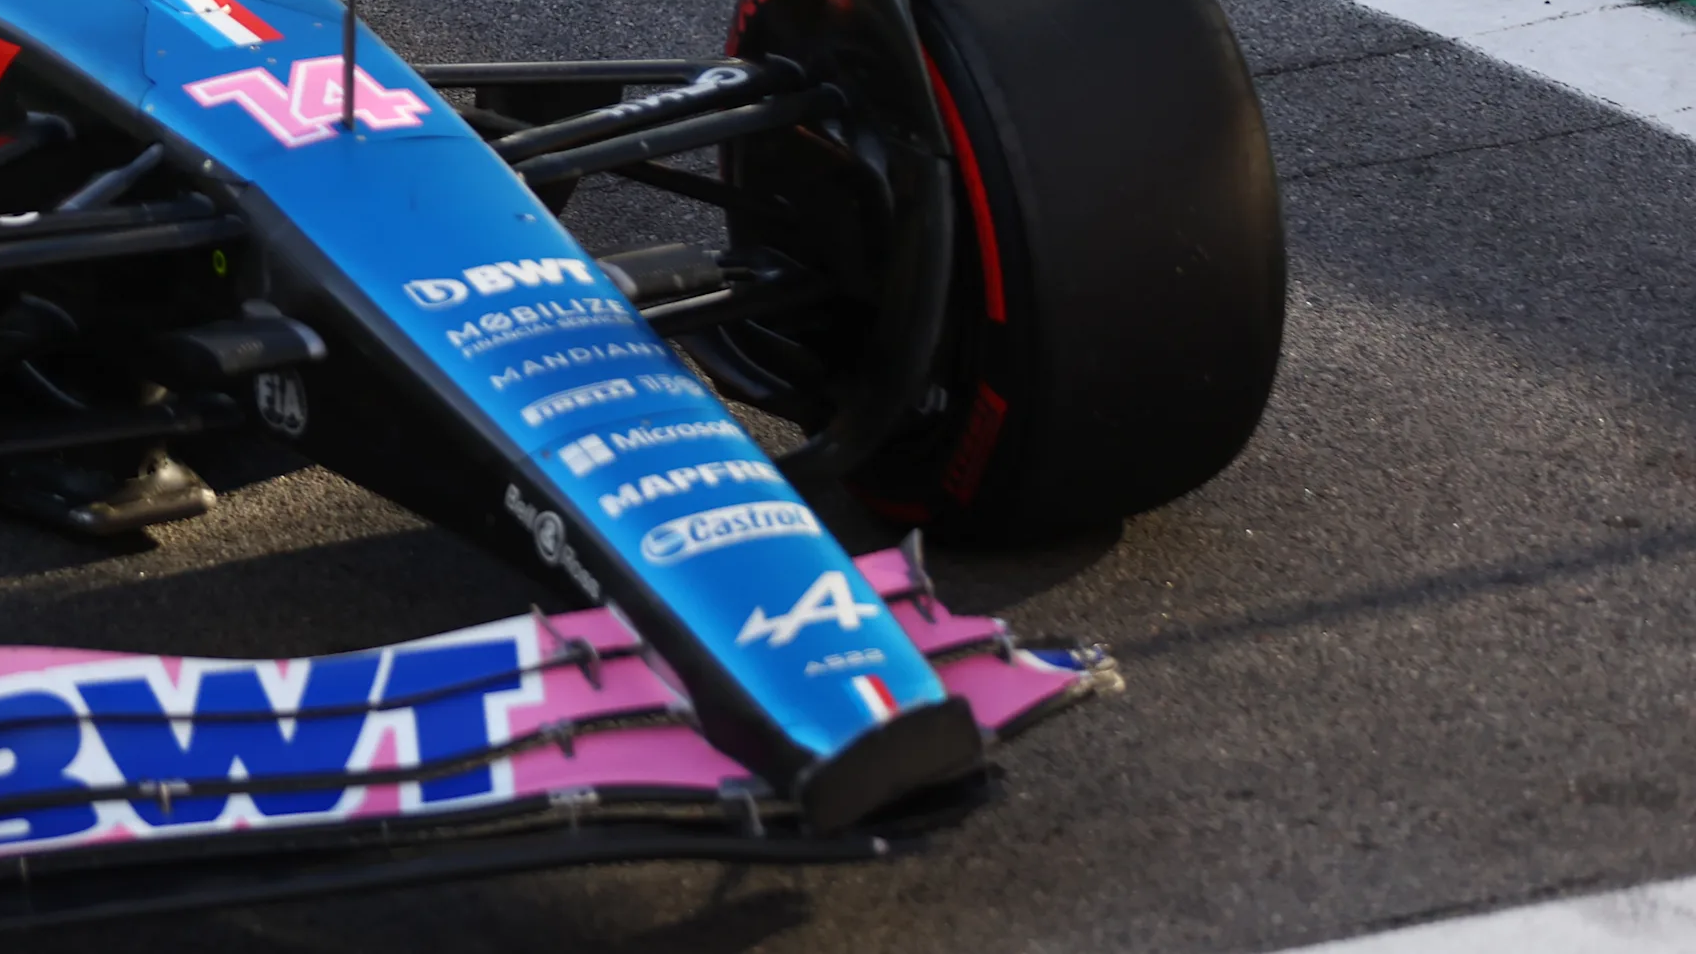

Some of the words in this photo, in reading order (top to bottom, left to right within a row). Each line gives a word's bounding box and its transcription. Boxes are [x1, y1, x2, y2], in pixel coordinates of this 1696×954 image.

[183, 54, 431, 148] 14
[463, 257, 595, 295] BWT
[489, 341, 667, 391] MANDIANT
[257, 372, 305, 423] FIA
